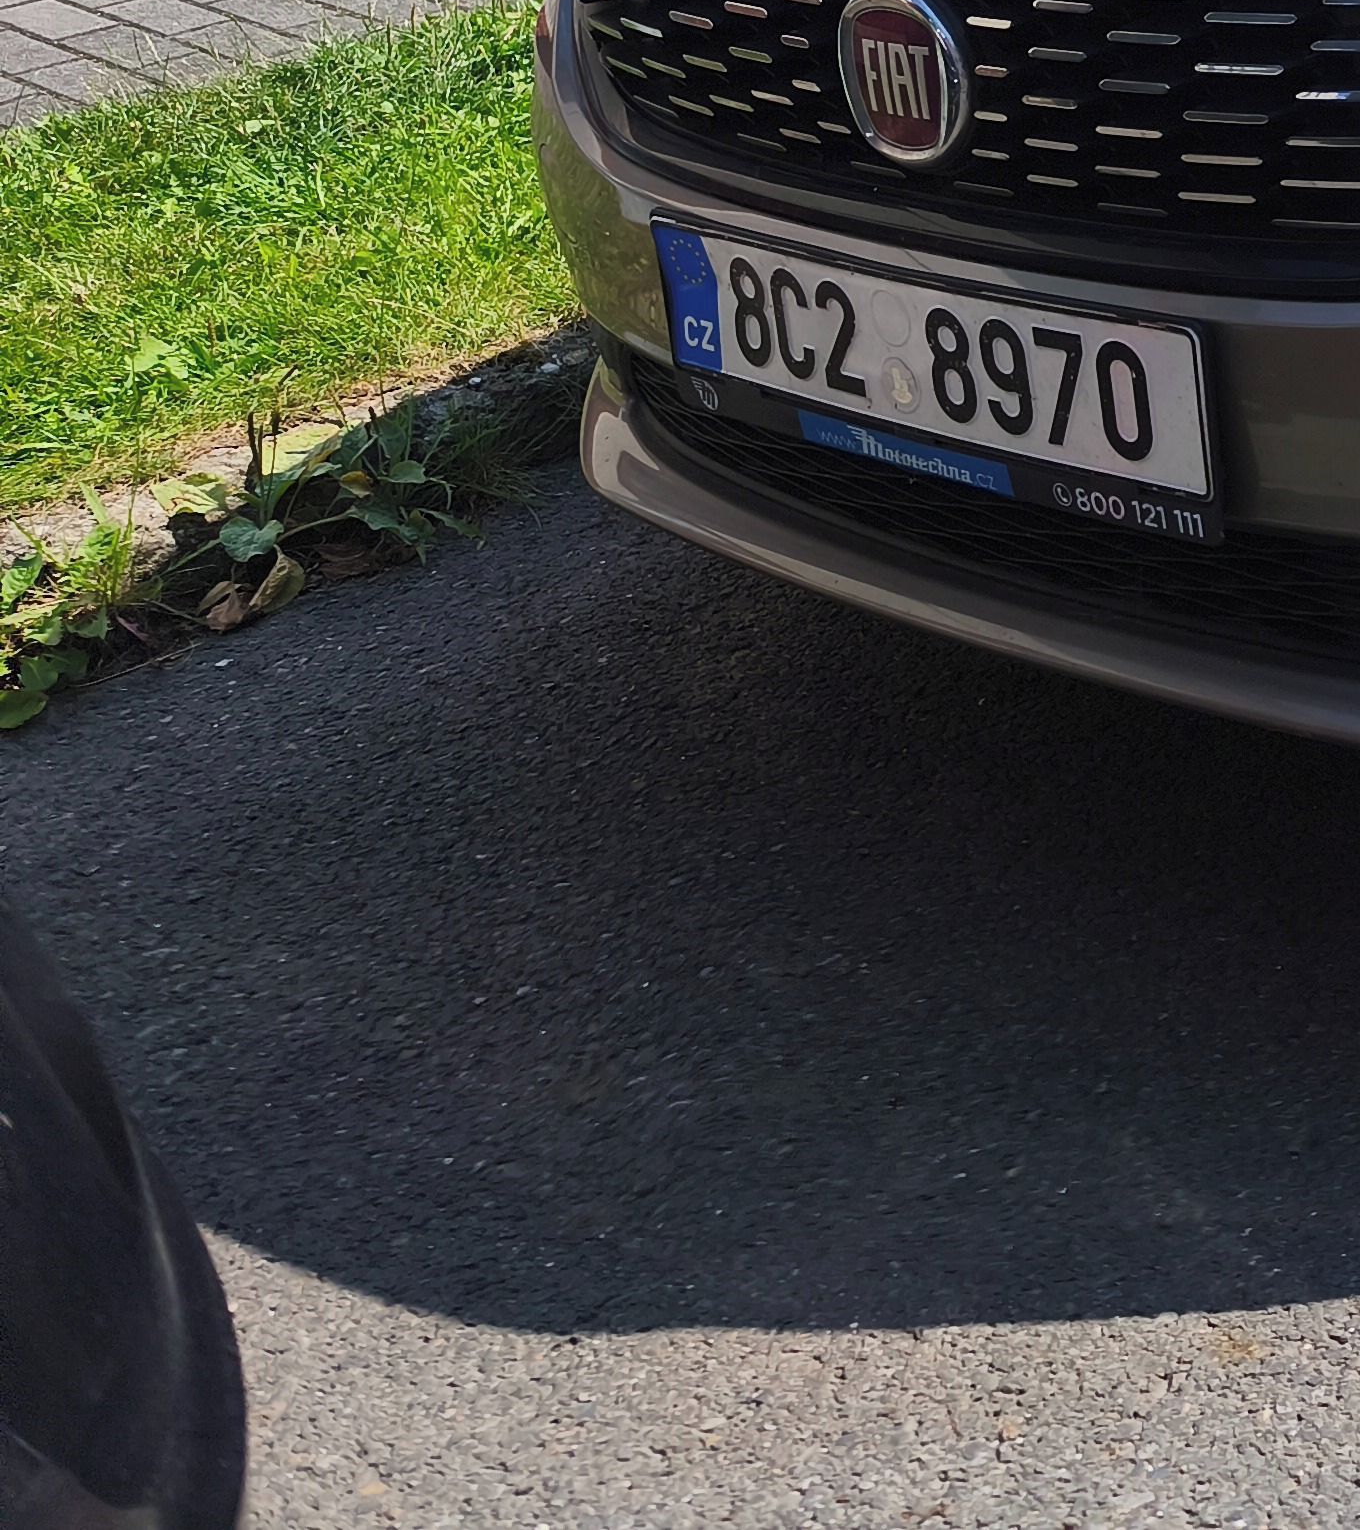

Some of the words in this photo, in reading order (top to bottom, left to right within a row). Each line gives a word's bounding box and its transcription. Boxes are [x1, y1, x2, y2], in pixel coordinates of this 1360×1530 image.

[861, 38, 931, 120] FIAT
[683, 315, 715, 352] CZ
[729, 256, 867, 399] 8C2
[925, 307, 1154, 462] 8970
[1075, 487, 1125, 520] 800
[1131, 500, 1167, 530] 121
[1173, 509, 1204, 538] 111
